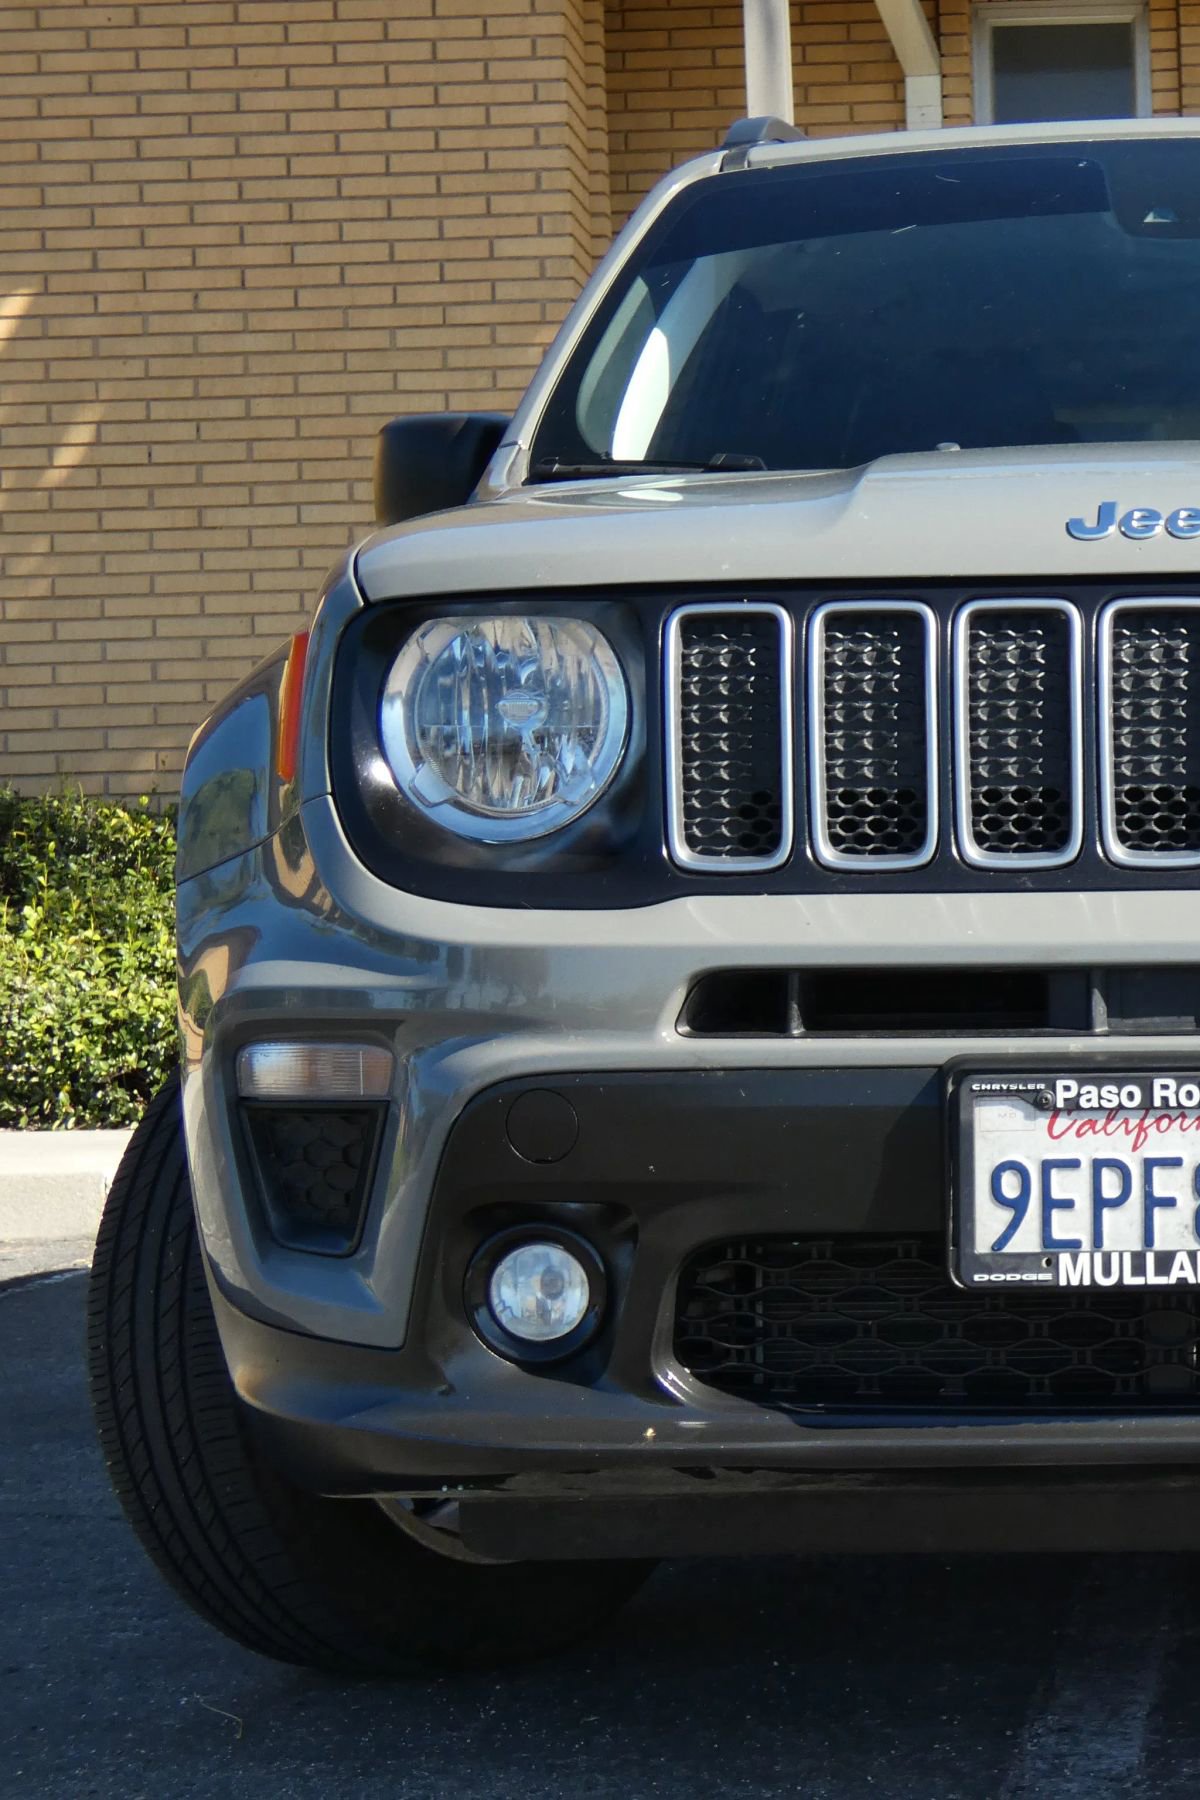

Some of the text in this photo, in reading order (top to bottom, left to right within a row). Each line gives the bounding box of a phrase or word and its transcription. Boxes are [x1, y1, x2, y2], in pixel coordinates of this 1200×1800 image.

[971, 1083, 1046, 1091] CHRYSLER
[1055, 1079, 1142, 1108] Paso
[973, 1273, 1053, 1281] DODGE
